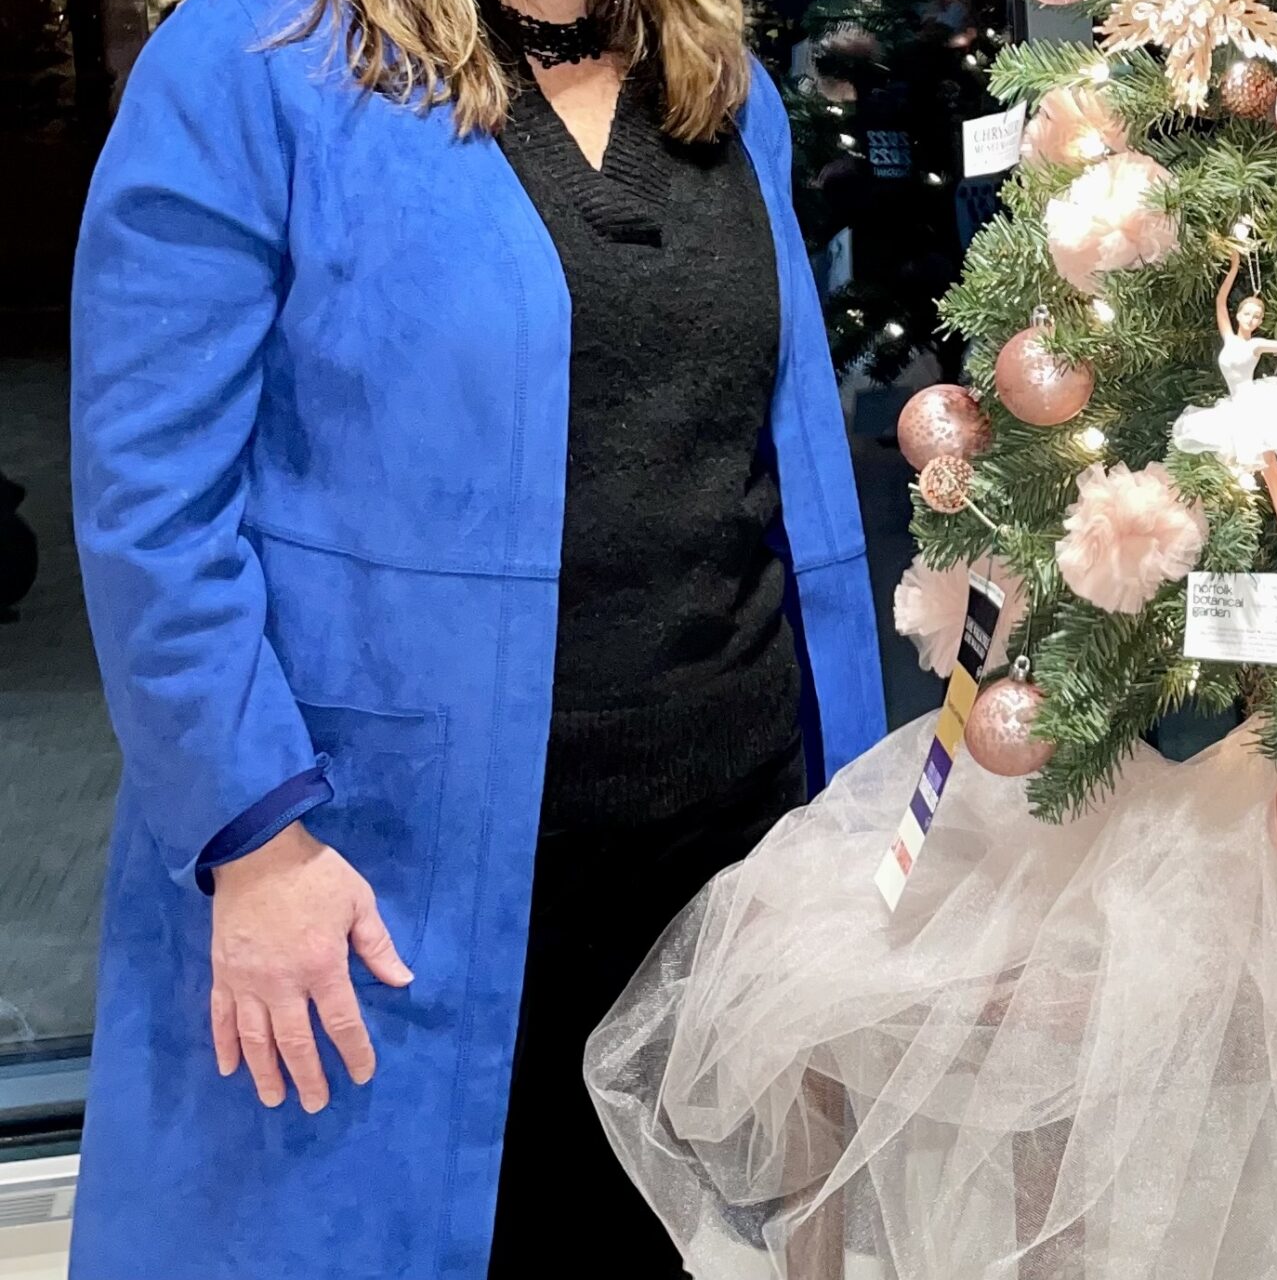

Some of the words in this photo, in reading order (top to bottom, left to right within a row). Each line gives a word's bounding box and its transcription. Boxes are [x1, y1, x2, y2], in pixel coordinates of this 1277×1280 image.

[1193, 583, 1233, 596] norfolk
[1193, 595, 1244, 608] botanical
[1192, 606, 1231, 618] garden
